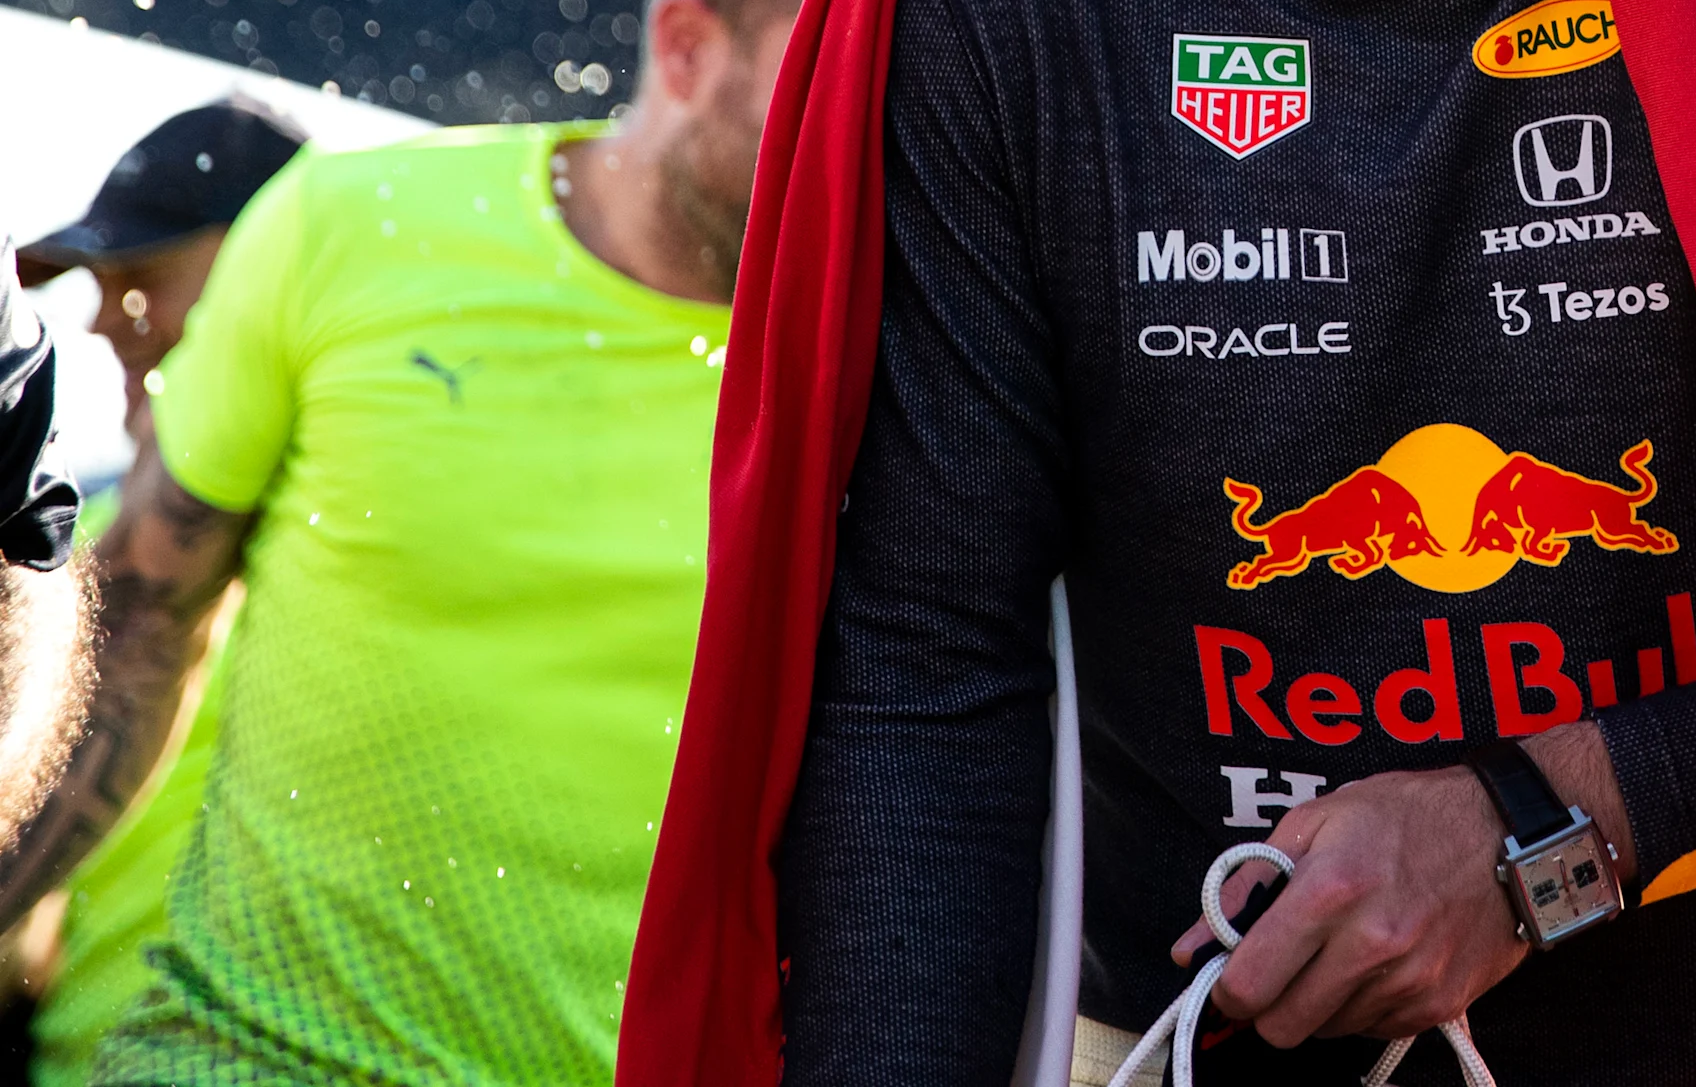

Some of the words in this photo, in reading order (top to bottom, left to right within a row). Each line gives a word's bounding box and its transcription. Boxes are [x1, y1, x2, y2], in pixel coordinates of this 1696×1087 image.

[1185, 43, 1299, 83] TAG
[1180, 90, 1303, 150] HEUER
[1137, 228, 1291, 283] Mobil
[1480, 210, 1661, 256] HONDA
[1538, 281, 1670, 324] Tezos
[1138, 321, 1353, 361] ORACLE
[1194, 617, 1464, 746] Red
